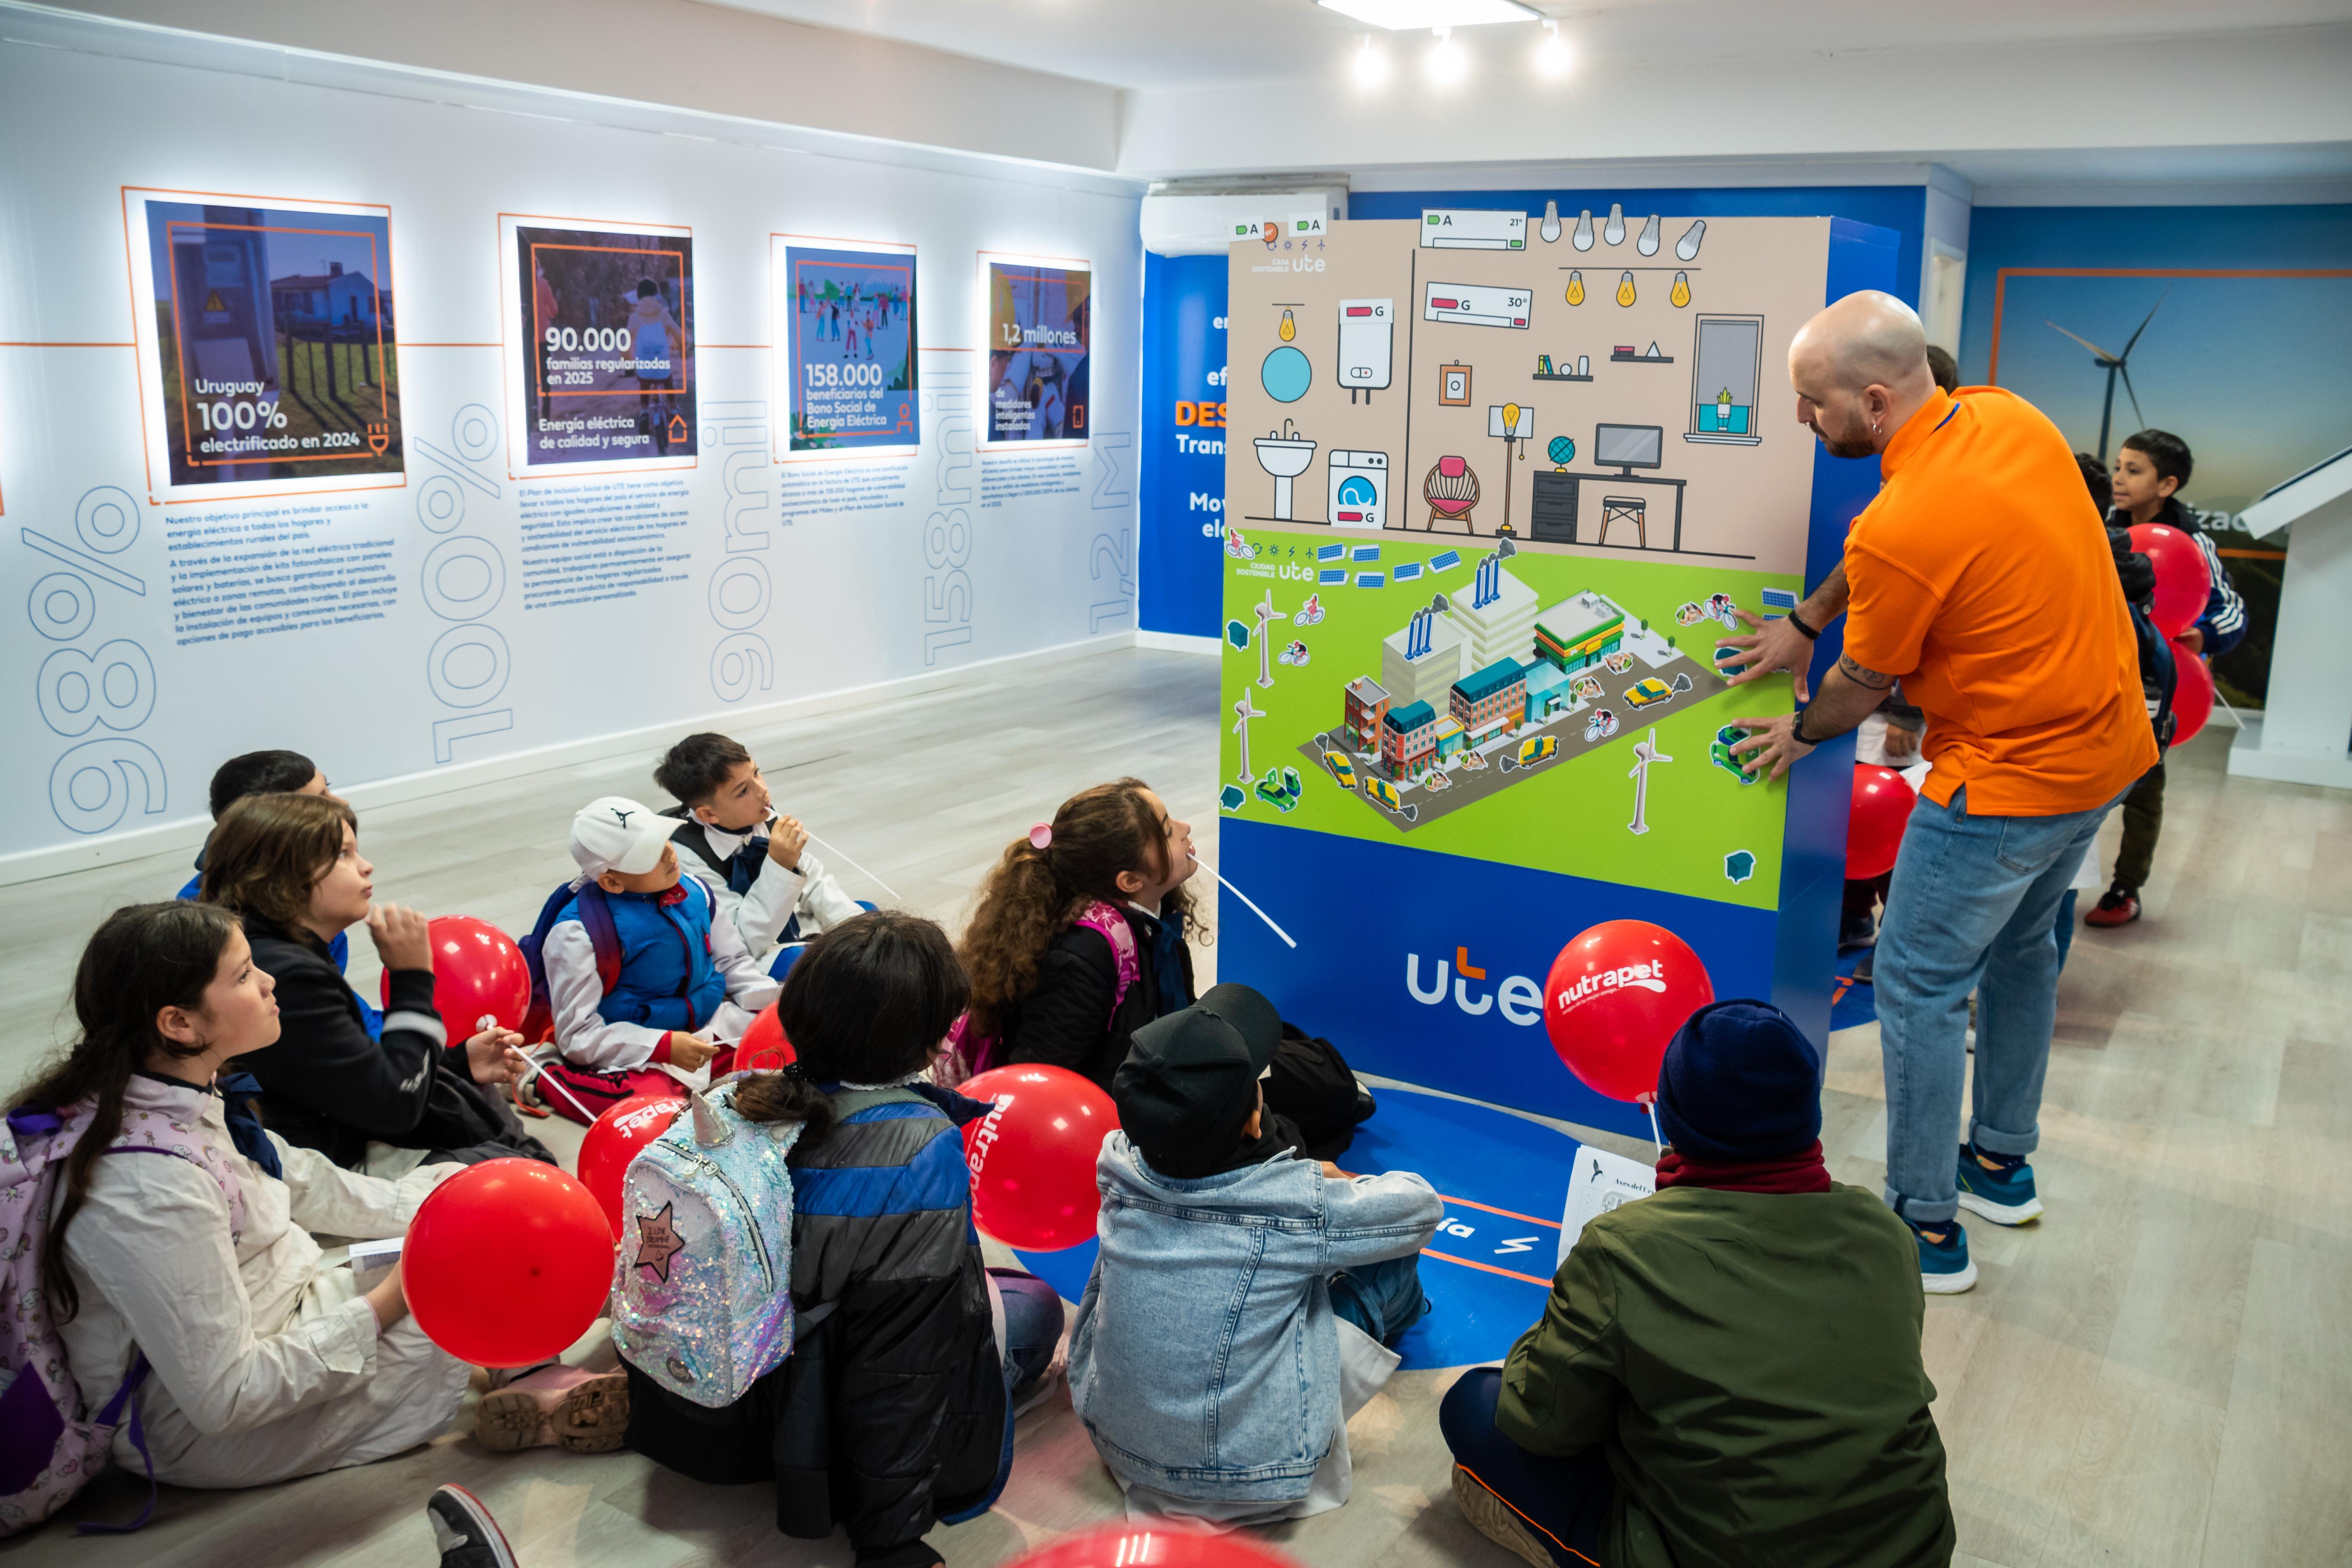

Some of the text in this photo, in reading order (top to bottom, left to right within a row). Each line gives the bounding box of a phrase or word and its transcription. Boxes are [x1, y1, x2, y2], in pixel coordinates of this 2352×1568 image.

[1250, 224, 1258, 234] A
[1312, 220, 1320, 230] A
[1443, 215, 1522, 226] A 21°
[1293, 254, 1326, 272] ute
[1375, 307, 1384, 317] G
[1461, 297, 1527, 311] G 30°
[545, 327, 632, 352] 90.000
[1002, 323, 1077, 346] 1,2 millones
[546, 357, 671, 373] familias regularizadas
[547, 371, 594, 385] en 2025
[806, 363, 883, 387] 158.000
[195, 378, 264, 398] Uruguay
[806, 387, 884, 403] beneficiarios del
[995, 387, 1006, 399] de
[196, 400, 288, 431] 100%
[806, 400, 877, 416] Bono Social de
[539, 415, 635, 433] Energía eléctrica
[807, 412, 887, 430] Energía Eléctrica
[200, 431, 361, 454] electrificado en 2024
[539, 433, 650, 449] de calidad y segura
[1176, 434, 1226, 455] Tran
[1091, 432, 1131, 511] M
[1366, 513, 1374, 523] G
[1236, 568, 1275, 579] SOSTENIBLE
[1250, 563, 1276, 572] CIUDAD
[1279, 561, 1314, 582] ute
[414, 403, 514, 764] 100%
[21, 485, 168, 834] 98%
[1406, 946, 1544, 1026] ute
[1558, 959, 1663, 1010] nutrapet
